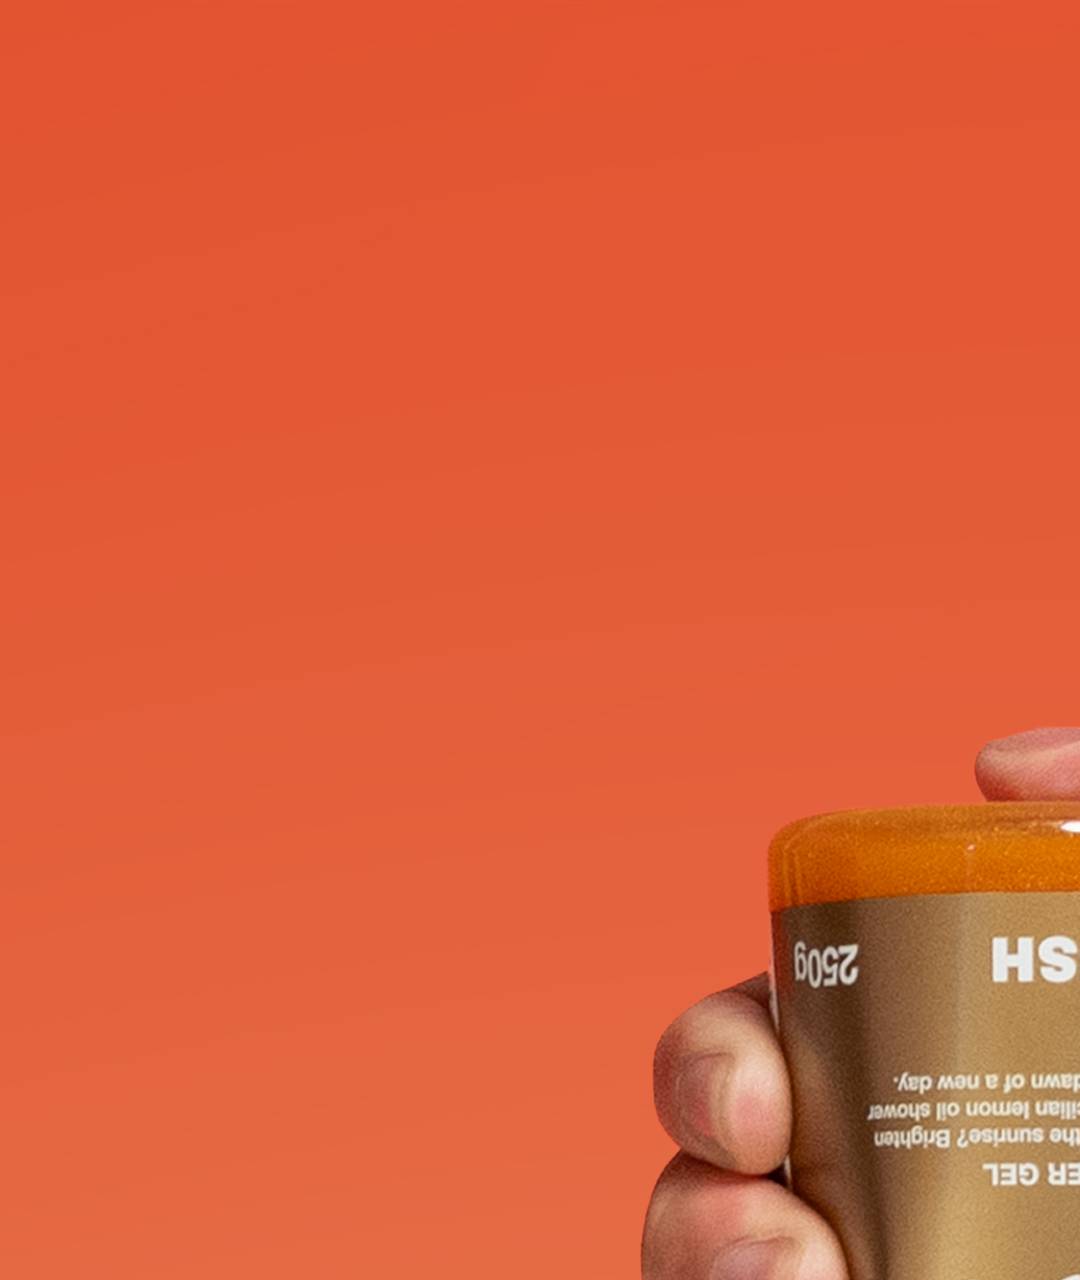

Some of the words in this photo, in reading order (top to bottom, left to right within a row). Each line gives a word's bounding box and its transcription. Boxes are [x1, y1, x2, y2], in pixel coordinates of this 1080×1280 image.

[794, 941, 859, 989] 250g
[893, 1071, 934, 1095] day.
[937, 1074, 981, 1090] new
[984, 1073, 999, 1090] a
[1003, 1073, 1026, 1094] of
[867, 1102, 932, 1122] shower
[936, 1101, 961, 1121] oil
[965, 1100, 1030, 1120] lemon
[874, 1125, 951, 1149] Brighten
[956, 1127, 1045, 1149] sunrise?
[982, 1162, 1040, 1186] GEL
